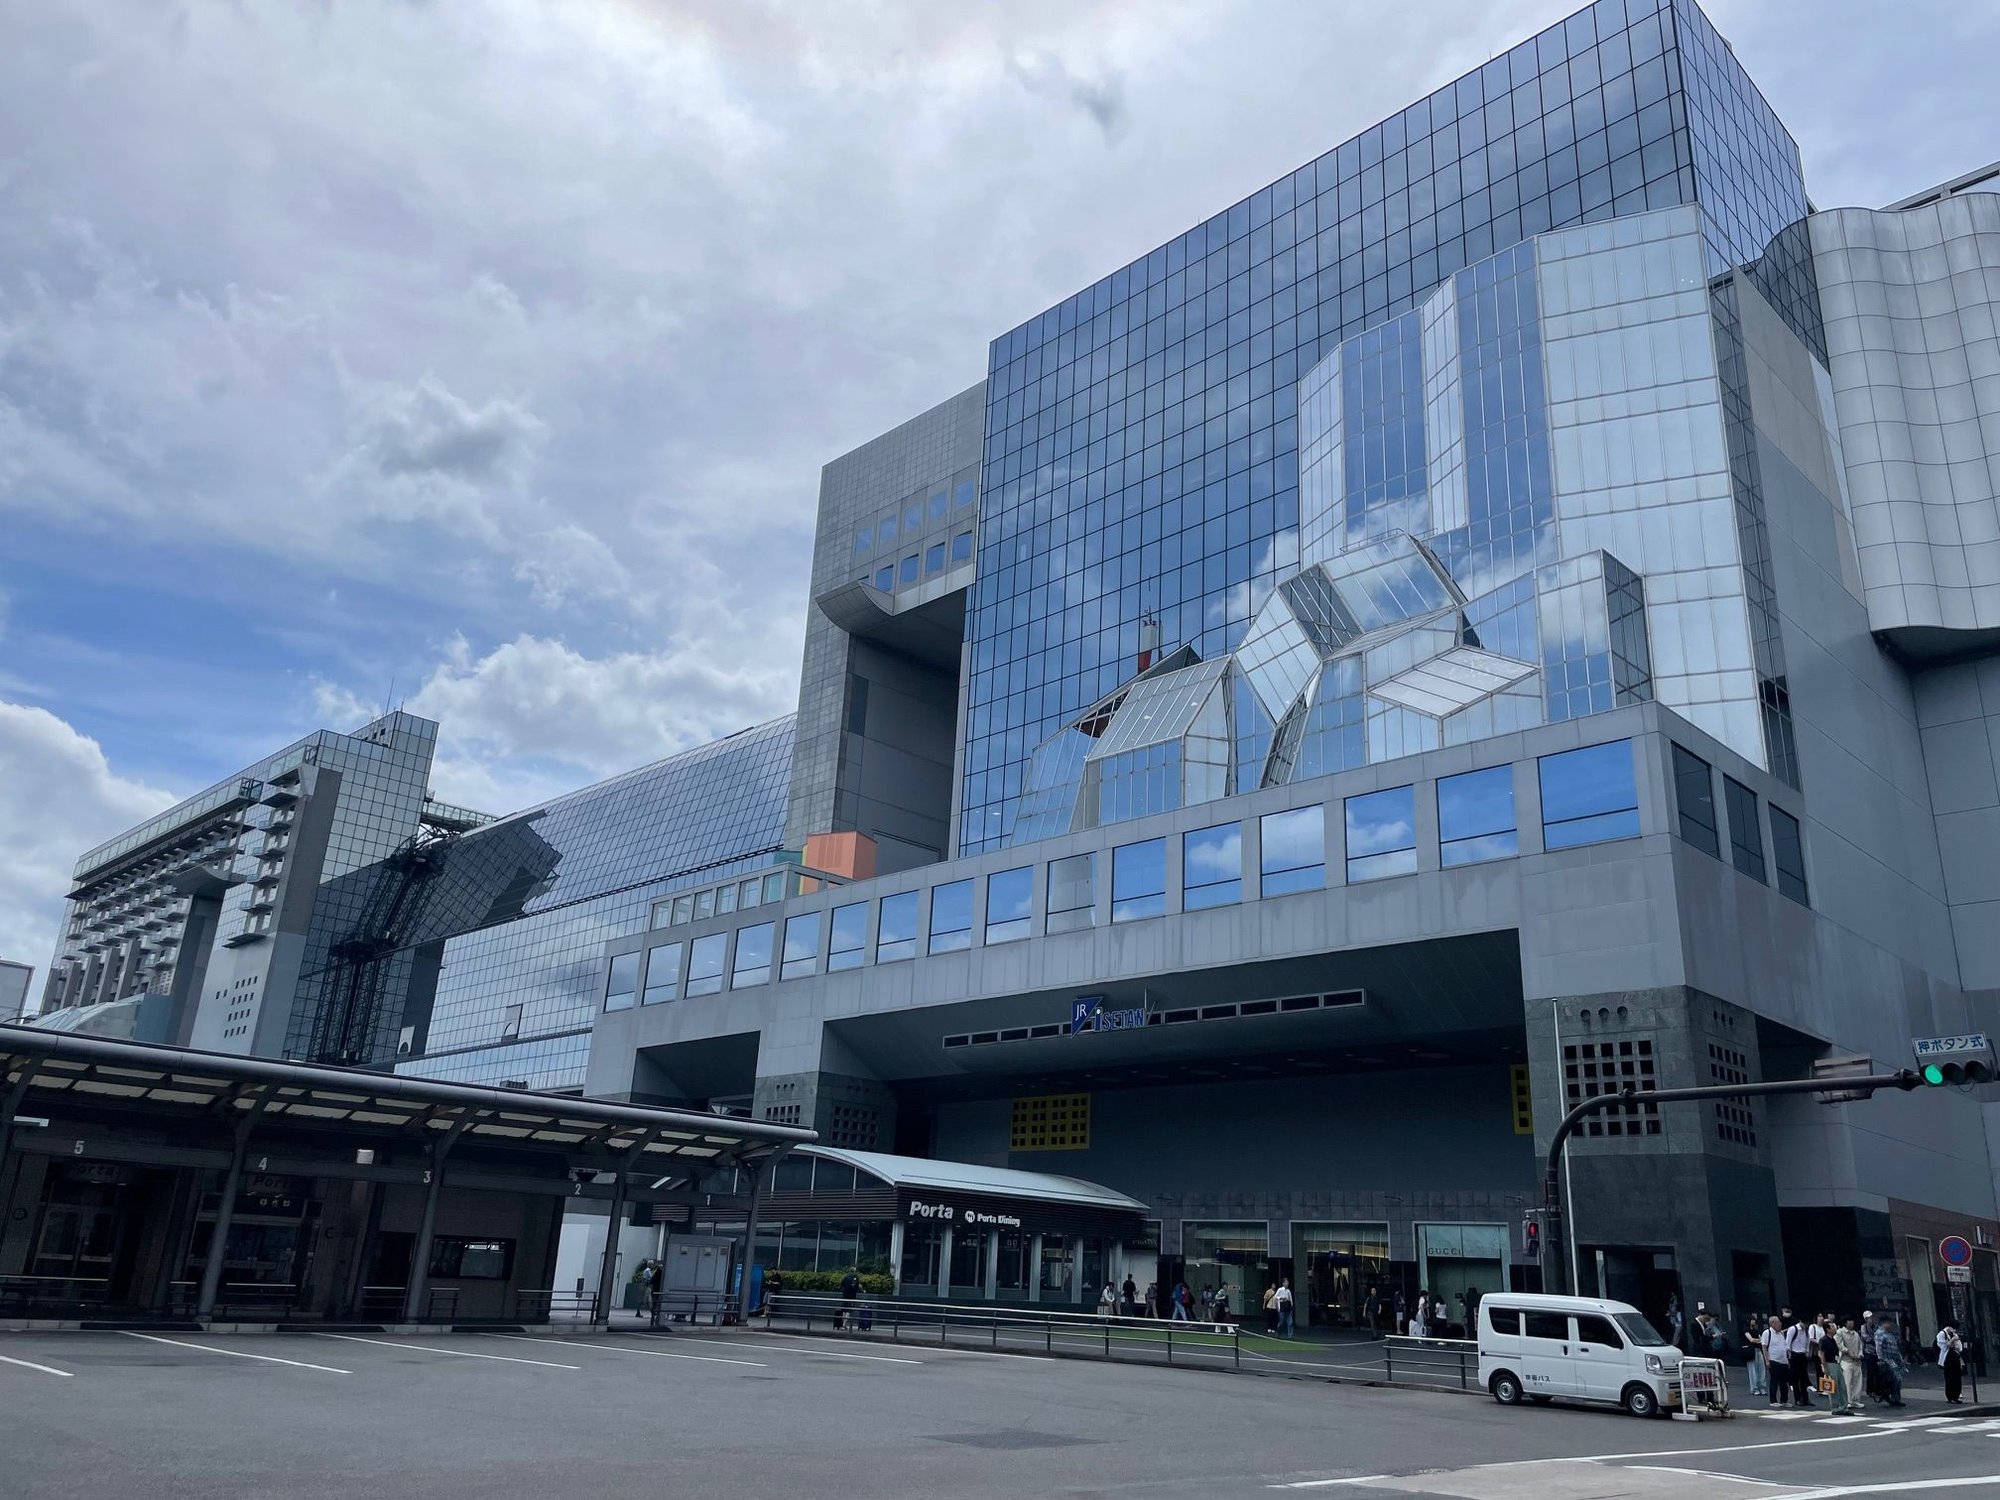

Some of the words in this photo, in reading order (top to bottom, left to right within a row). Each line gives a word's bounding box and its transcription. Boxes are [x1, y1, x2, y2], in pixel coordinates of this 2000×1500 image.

[1074, 1003, 1087, 1022] JR
[1917, 1035, 1984, 1054] 押ボタン式
[73, 1140, 85, 1155] 5
[257, 1157, 268, 1170] 4
[423, 1170, 431, 1184] 3
[575, 1183, 582, 1196] 2
[909, 1200, 954, 1219] Porta
[976, 1212, 997, 1223] Porta
[997, 1214, 1021, 1228] Dining
[1428, 1247, 1461, 1255] GUCCI
